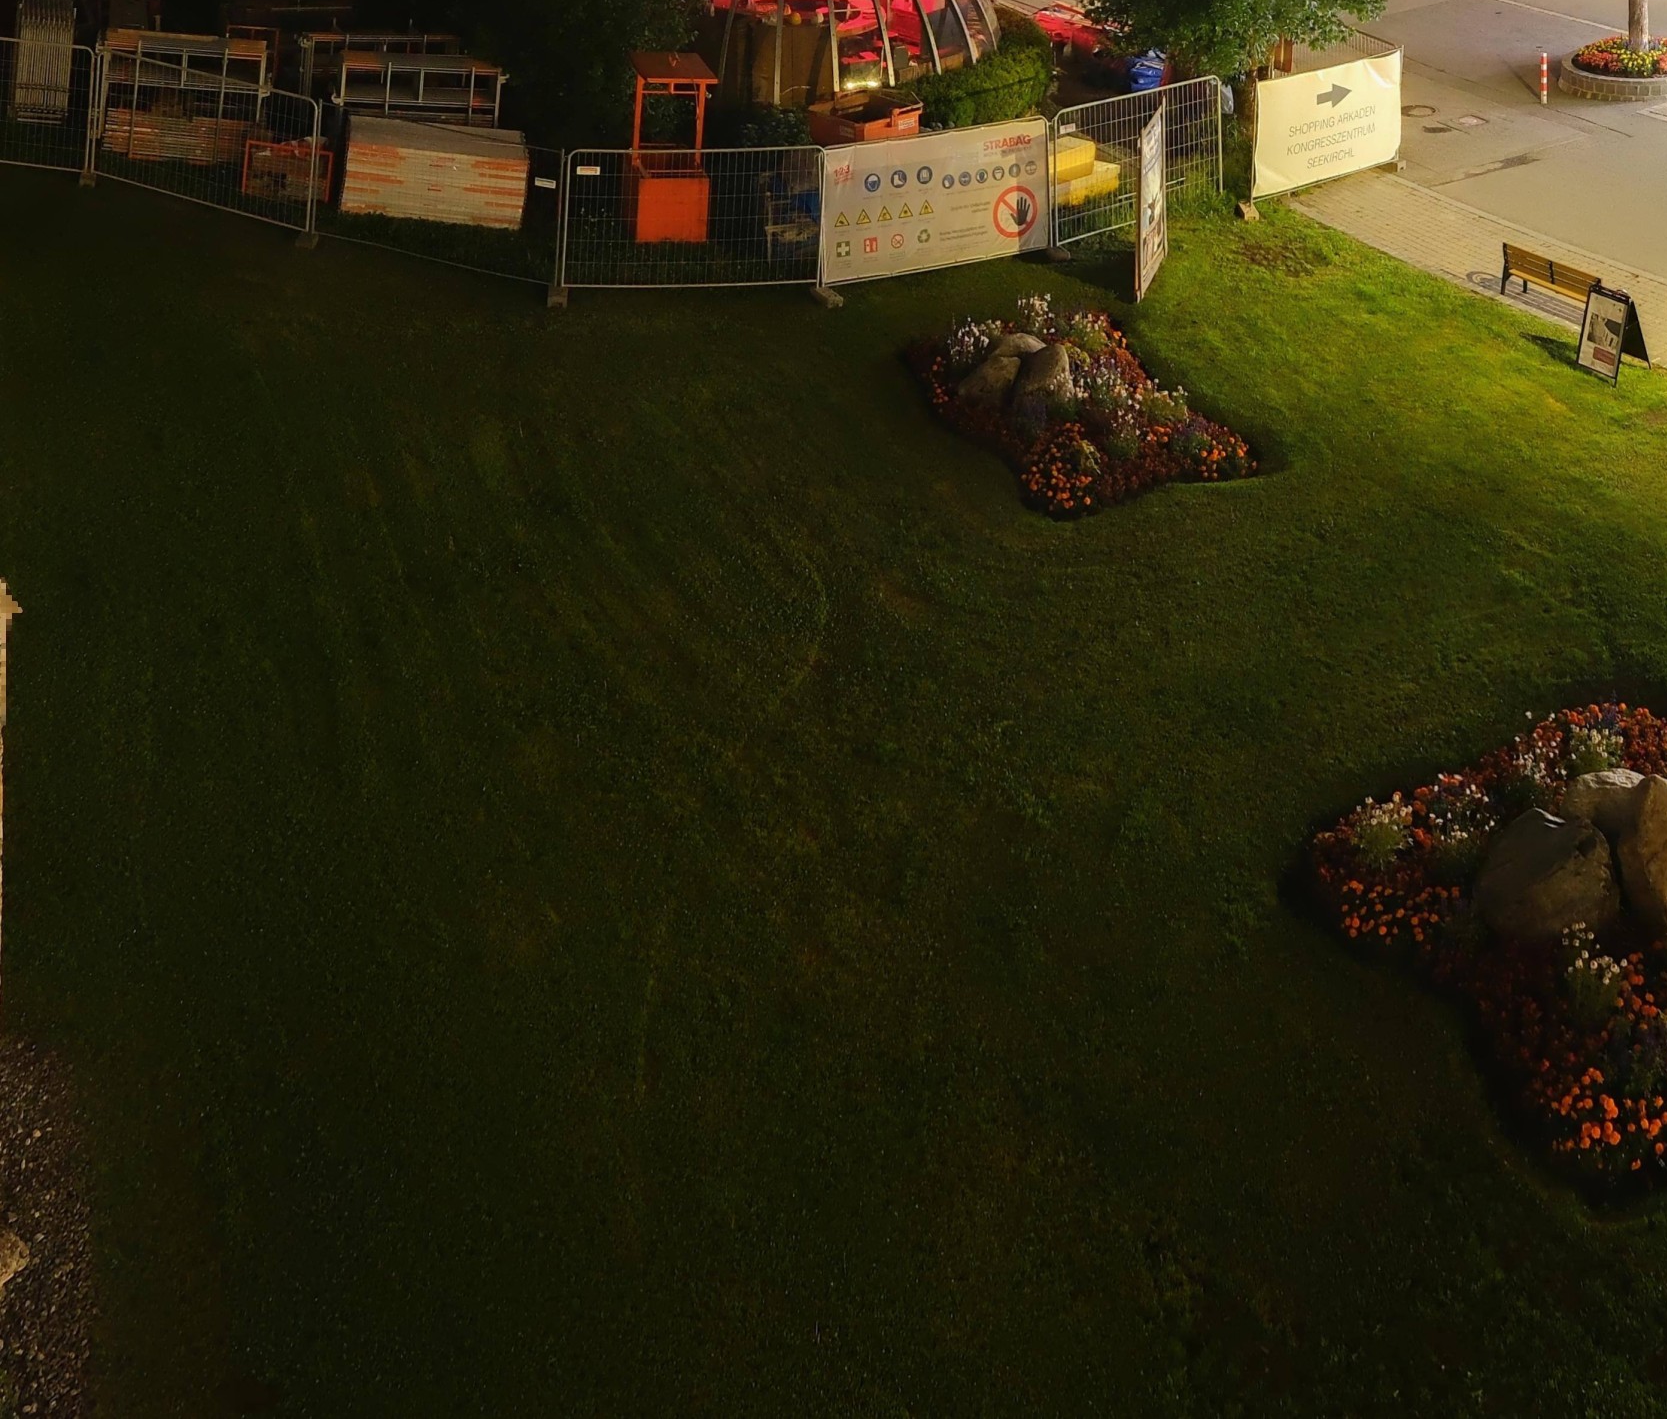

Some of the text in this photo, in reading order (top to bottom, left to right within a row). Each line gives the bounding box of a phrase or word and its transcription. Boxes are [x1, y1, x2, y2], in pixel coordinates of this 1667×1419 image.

[1288, 105, 1376, 138] SHOPPING ARKADEN
[983, 134, 1032, 152] STRABAG
[1287, 123, 1376, 156] KONGRESSZENTRUM
[1307, 147, 1355, 169] SEEKIRCHL
